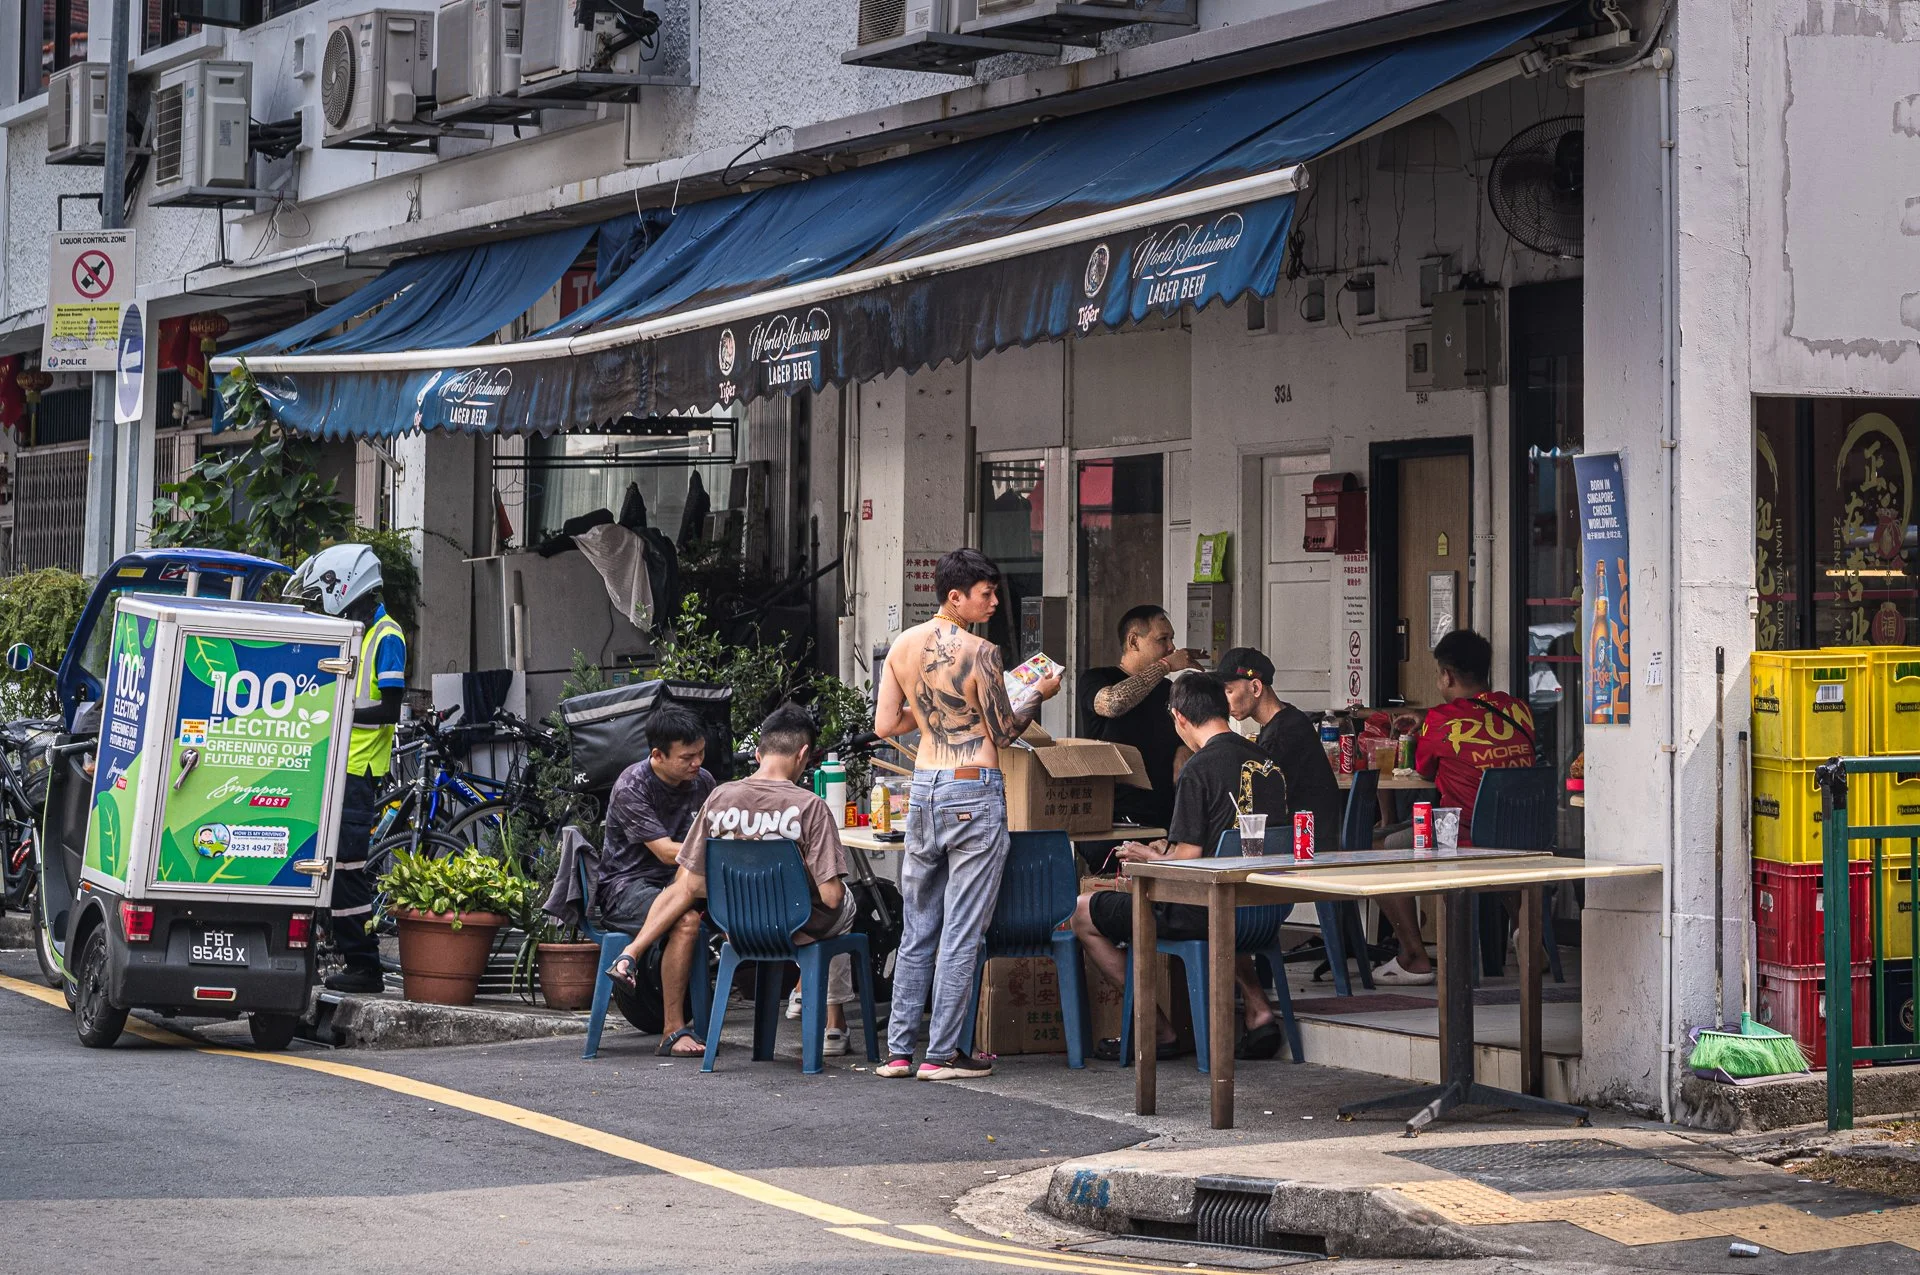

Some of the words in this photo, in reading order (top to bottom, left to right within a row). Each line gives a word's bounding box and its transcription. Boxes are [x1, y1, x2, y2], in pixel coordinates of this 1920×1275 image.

[60, 237, 81, 245] LIQUOR
[83, 236, 109, 244] CONTROL
[110, 235, 127, 243] ZONE
[1132, 222, 1190, 279] World
[1156, 212, 1244, 277] Acclaimed
[1147, 279, 1179, 305] LAGER
[1180, 273, 1206, 299] BEER
[1077, 303, 1100, 332] Tiger
[749, 314, 789, 361] World
[769, 307, 831, 361] Acclaimed
[60, 358, 87, 366] POLICE
[768, 362, 791, 386] LAGER
[792, 360, 812, 381] BEER
[438, 368, 482, 398] World
[454, 367, 513, 402] Acclaimed
[718, 380, 736, 404] Tiger
[1274, 383, 1292, 404] 33A
[449, 406, 470, 424] LAGER
[471, 408, 488, 426] BEER
[1590, 479, 1604, 491] BORN
[1604, 478, 1611, 490] IN
[1587, 491, 1616, 504] SINGAPORE.
[1592, 504, 1612, 516] CHOSEN
[1588, 516, 1620, 530] WORLDWIDE.
[1775, 518, 1783, 558] HUAN
[1776, 564, 1784, 597] YING
[1833, 581, 1841, 607] ZAI
[115, 651, 146, 700] 100%
[211, 670, 319, 718] 100%
[113, 697, 140, 721] ELECTRIC
[1814, 703, 1844, 711] Heineken
[208, 716, 312, 739] ELECTRIC
[1439, 700, 1535, 757] RUN
[204, 752, 254, 766] FUTURE
[257, 755, 275, 767] OF
[277, 757, 312, 769] POST
[205, 740, 278, 755] GREENING
[281, 744, 312, 757] OUR
[1471, 743, 1531, 763] MORE
[206, 775, 293, 804] Singapore
[258, 797, 287, 806] POST
[707, 805, 801, 840] YOUNG
[231, 843, 250, 851] 9231
[252, 844, 272, 852] 4947
[203, 932, 234, 947] FBT
[192, 946, 234, 961] 9549
[236, 947, 246, 962] X
